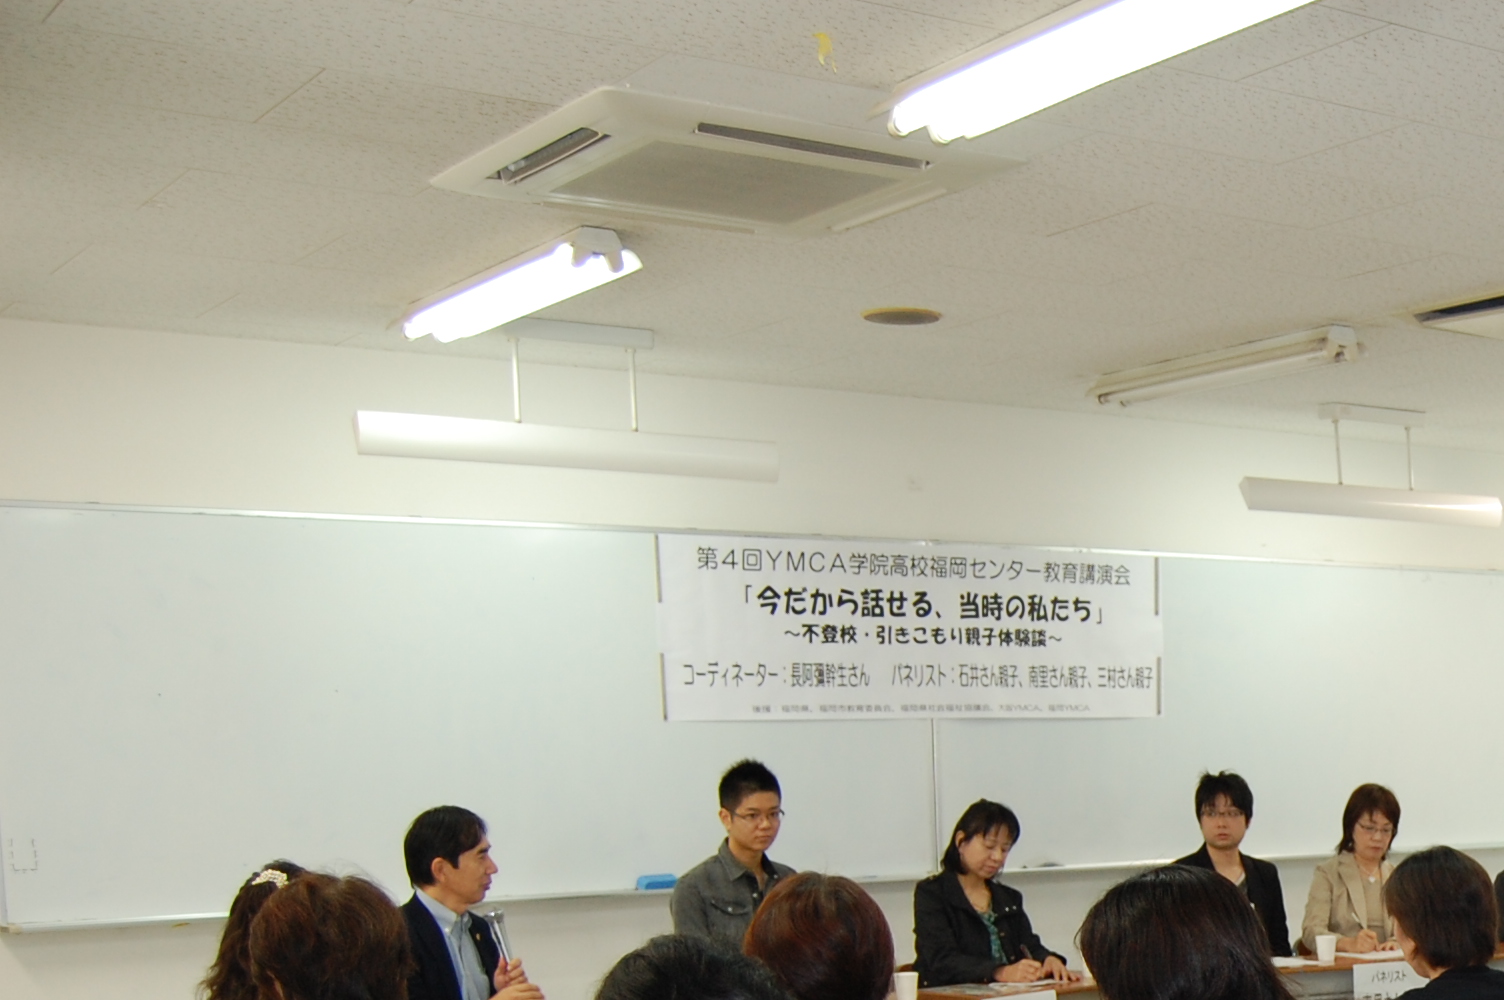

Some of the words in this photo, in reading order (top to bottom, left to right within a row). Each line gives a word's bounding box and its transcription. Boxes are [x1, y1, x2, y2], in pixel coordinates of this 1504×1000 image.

[696, 546, 1132, 586] 第4回YMCA学院高校福岡センター教育講演会
[745, 584, 1103, 625] 「今だから話せる、当時の私たち」
[1371, 969, 1407, 984] パネリスト
